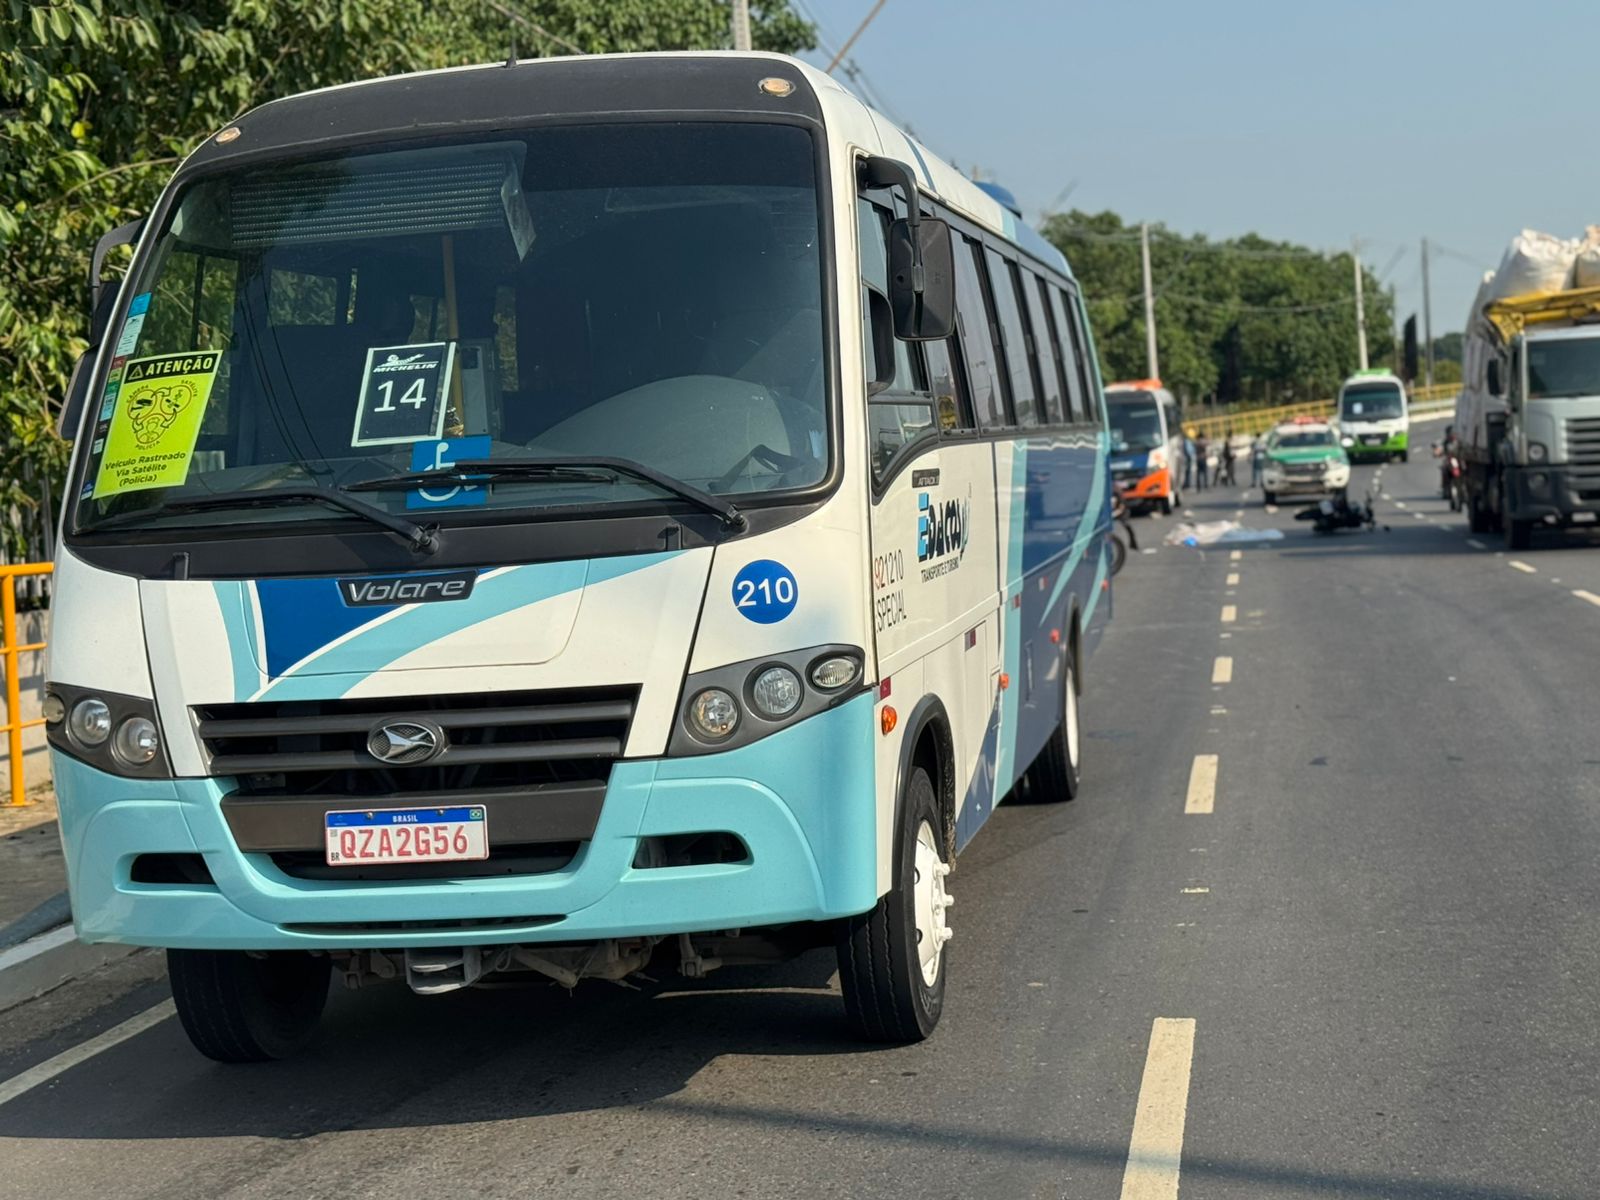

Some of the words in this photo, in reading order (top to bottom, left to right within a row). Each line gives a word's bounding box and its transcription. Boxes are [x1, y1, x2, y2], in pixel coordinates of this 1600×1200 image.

[145, 356, 214, 376] ATENÇÃO
[373, 364, 437, 373] MICHELIN
[374, 378, 427, 412] 14
[138, 451, 186, 464] Rastreado
[116, 467, 130, 478] Via
[131, 463, 167, 475] Satélite
[348, 579, 466, 602] Volare
[736, 576, 794, 607] 210
[392, 815, 418, 823] BRASIL
[340, 825, 468, 859] QZA2G56
[331, 852, 340, 861] BR
